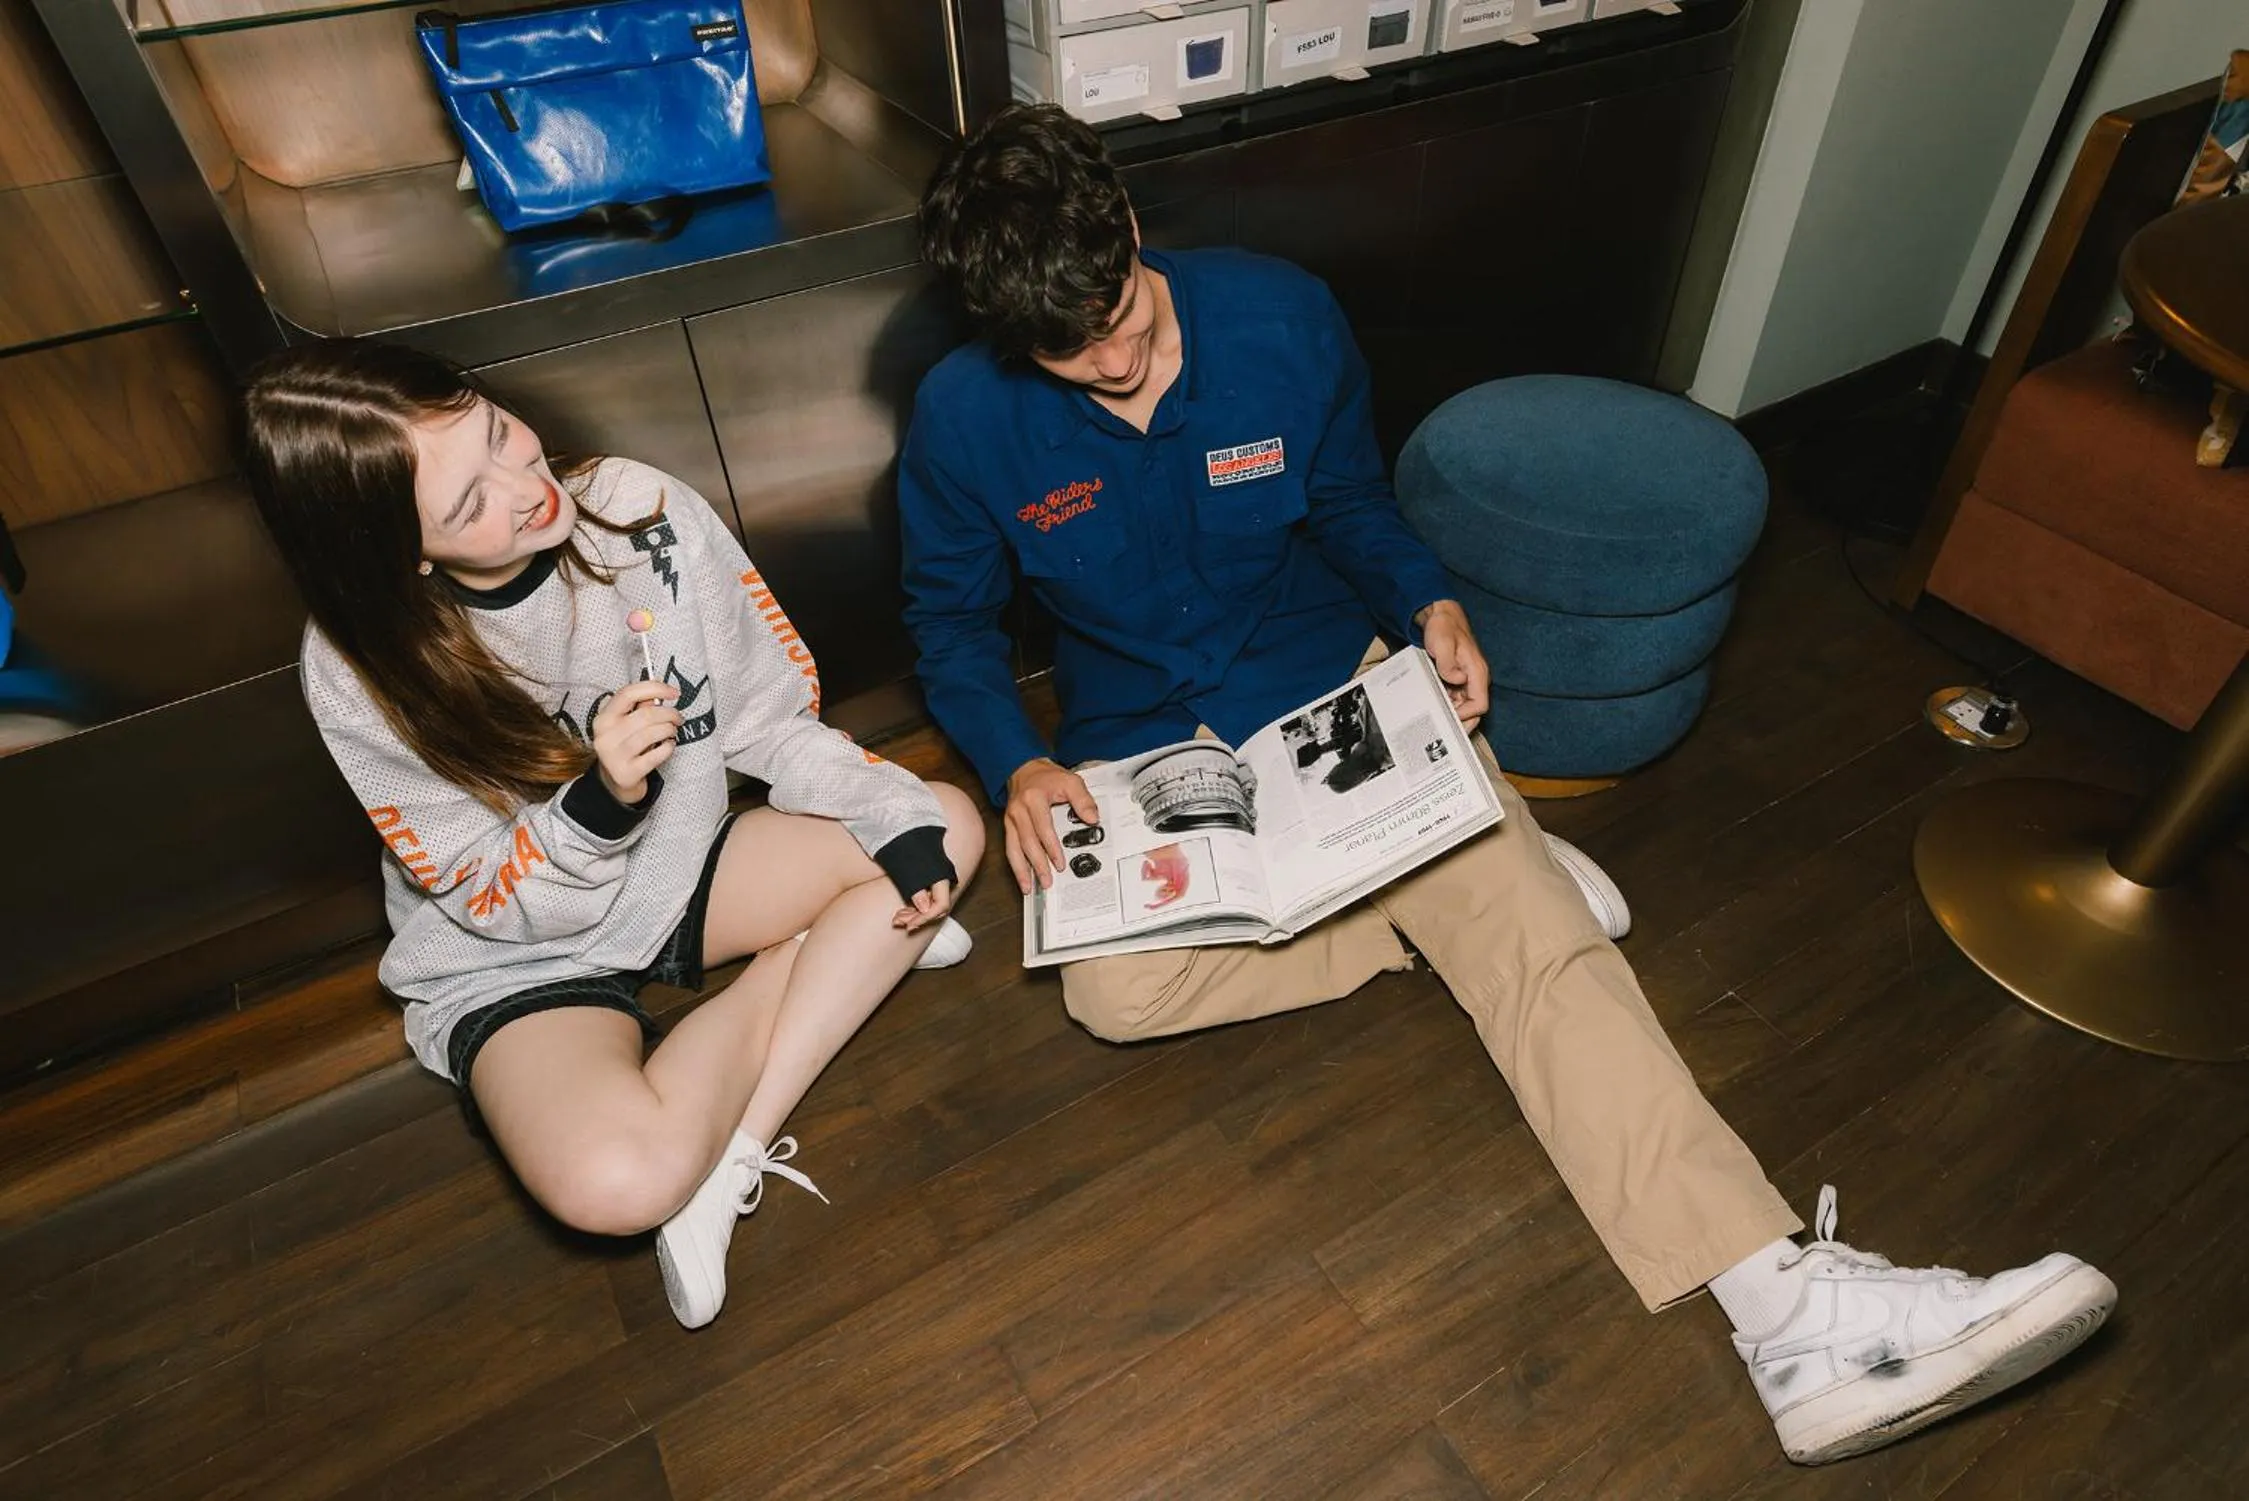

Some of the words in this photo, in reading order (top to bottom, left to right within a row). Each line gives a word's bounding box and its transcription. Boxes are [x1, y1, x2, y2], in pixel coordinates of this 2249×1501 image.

[1318, 32, 1336, 45] LOU
[1085, 88, 1100, 98] LOU
[1209, 450, 1234, 462] DEUS
[1236, 440, 1280, 458] CUSTOMS
[1344, 827, 1388, 853] Planar
